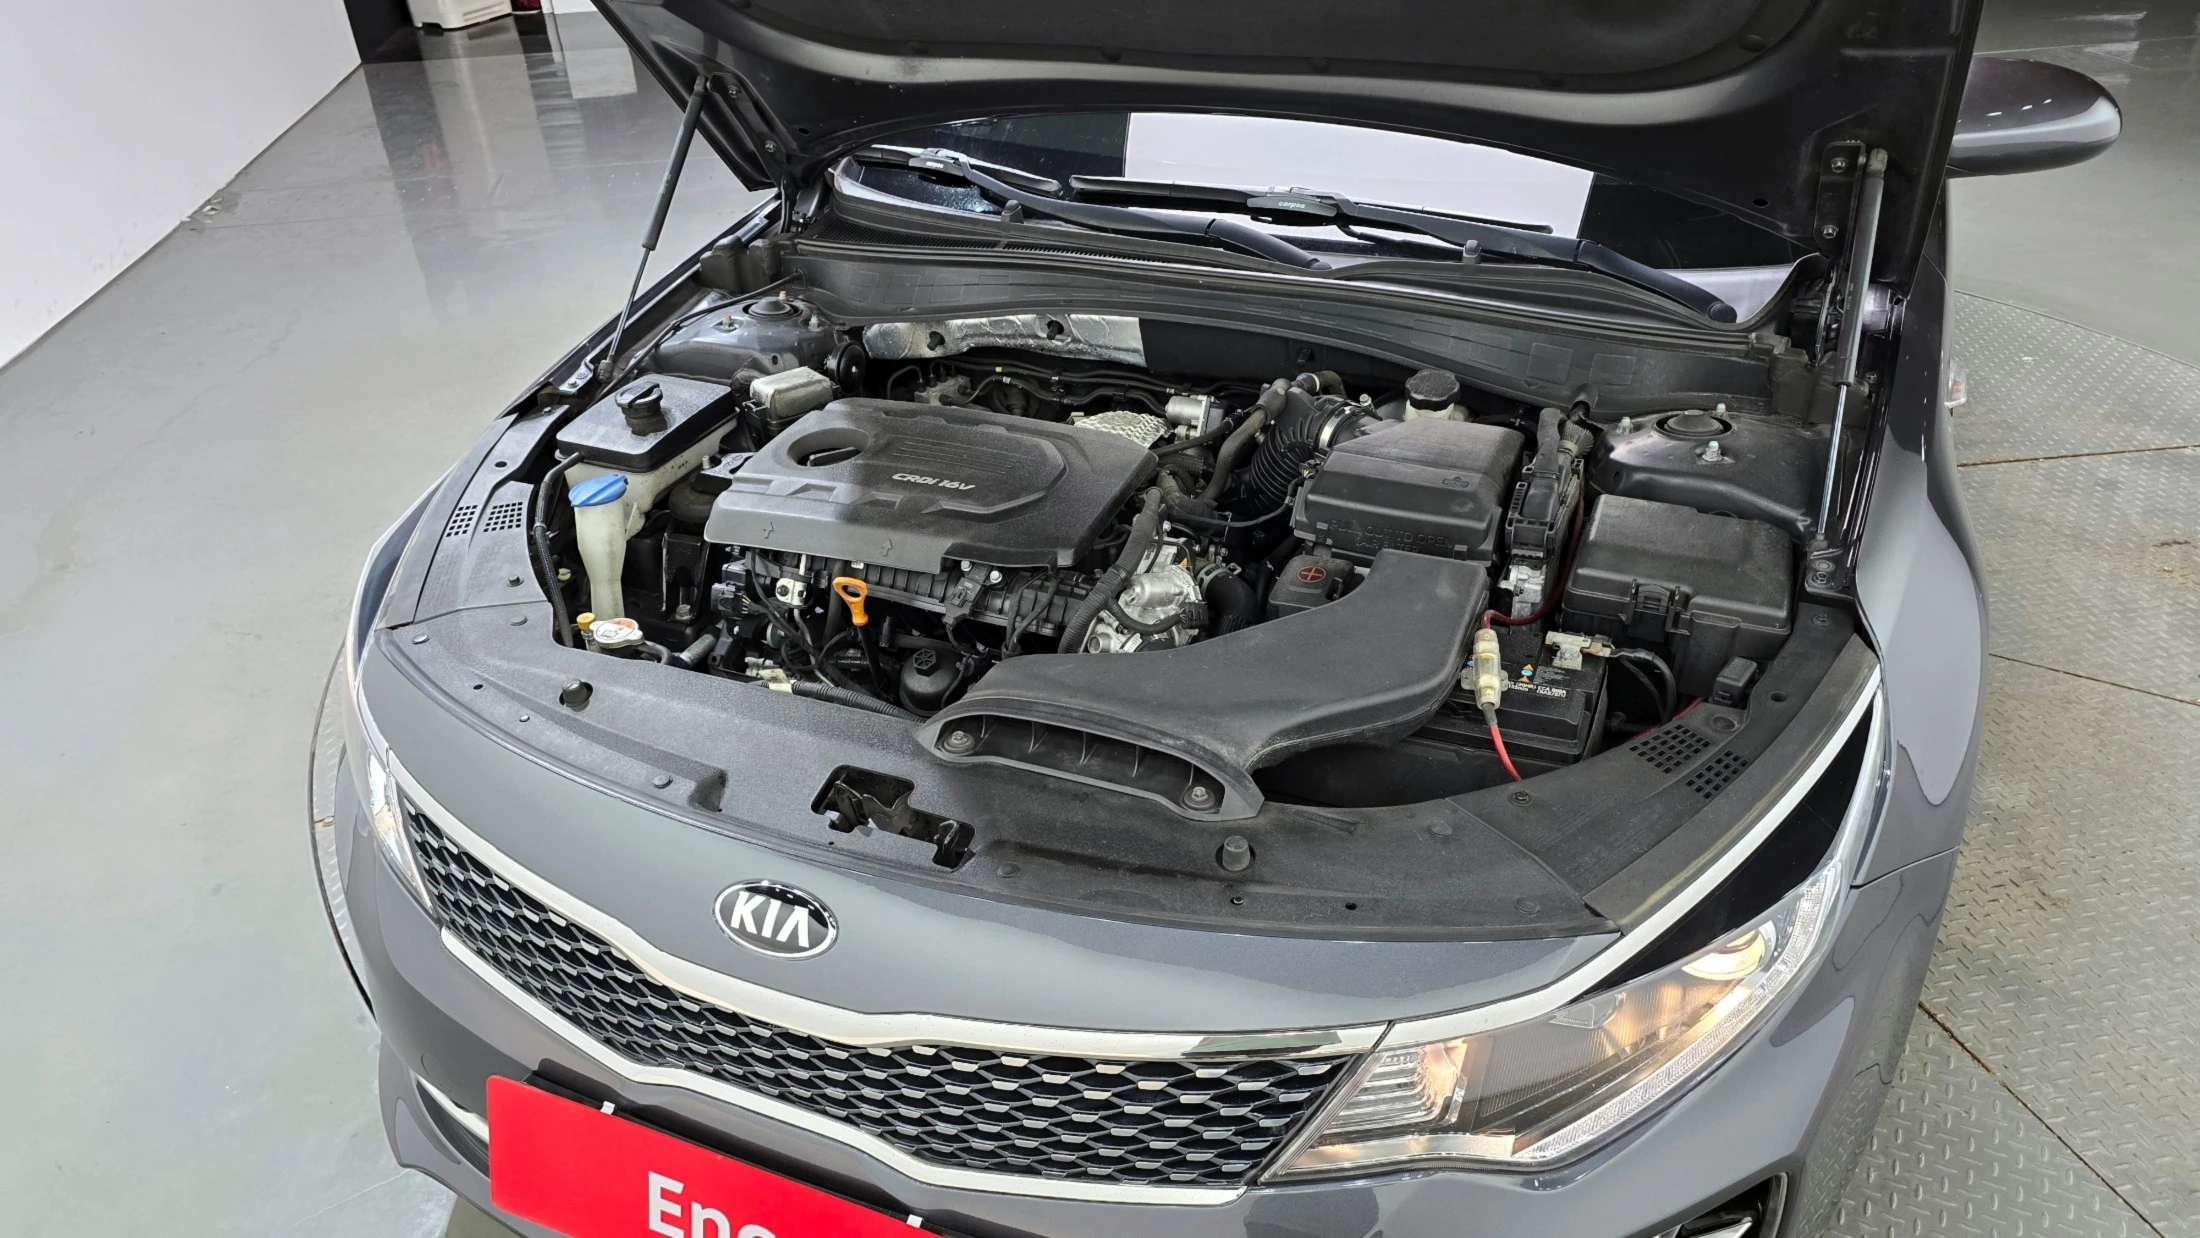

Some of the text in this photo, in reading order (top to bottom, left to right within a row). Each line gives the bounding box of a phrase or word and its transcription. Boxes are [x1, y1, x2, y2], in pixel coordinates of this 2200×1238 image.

[938, 480, 976, 490] 16V
[1417, 533, 1453, 548] OPEN
[730, 891, 810, 948] KIA
[648, 1170, 777, 1238] En
